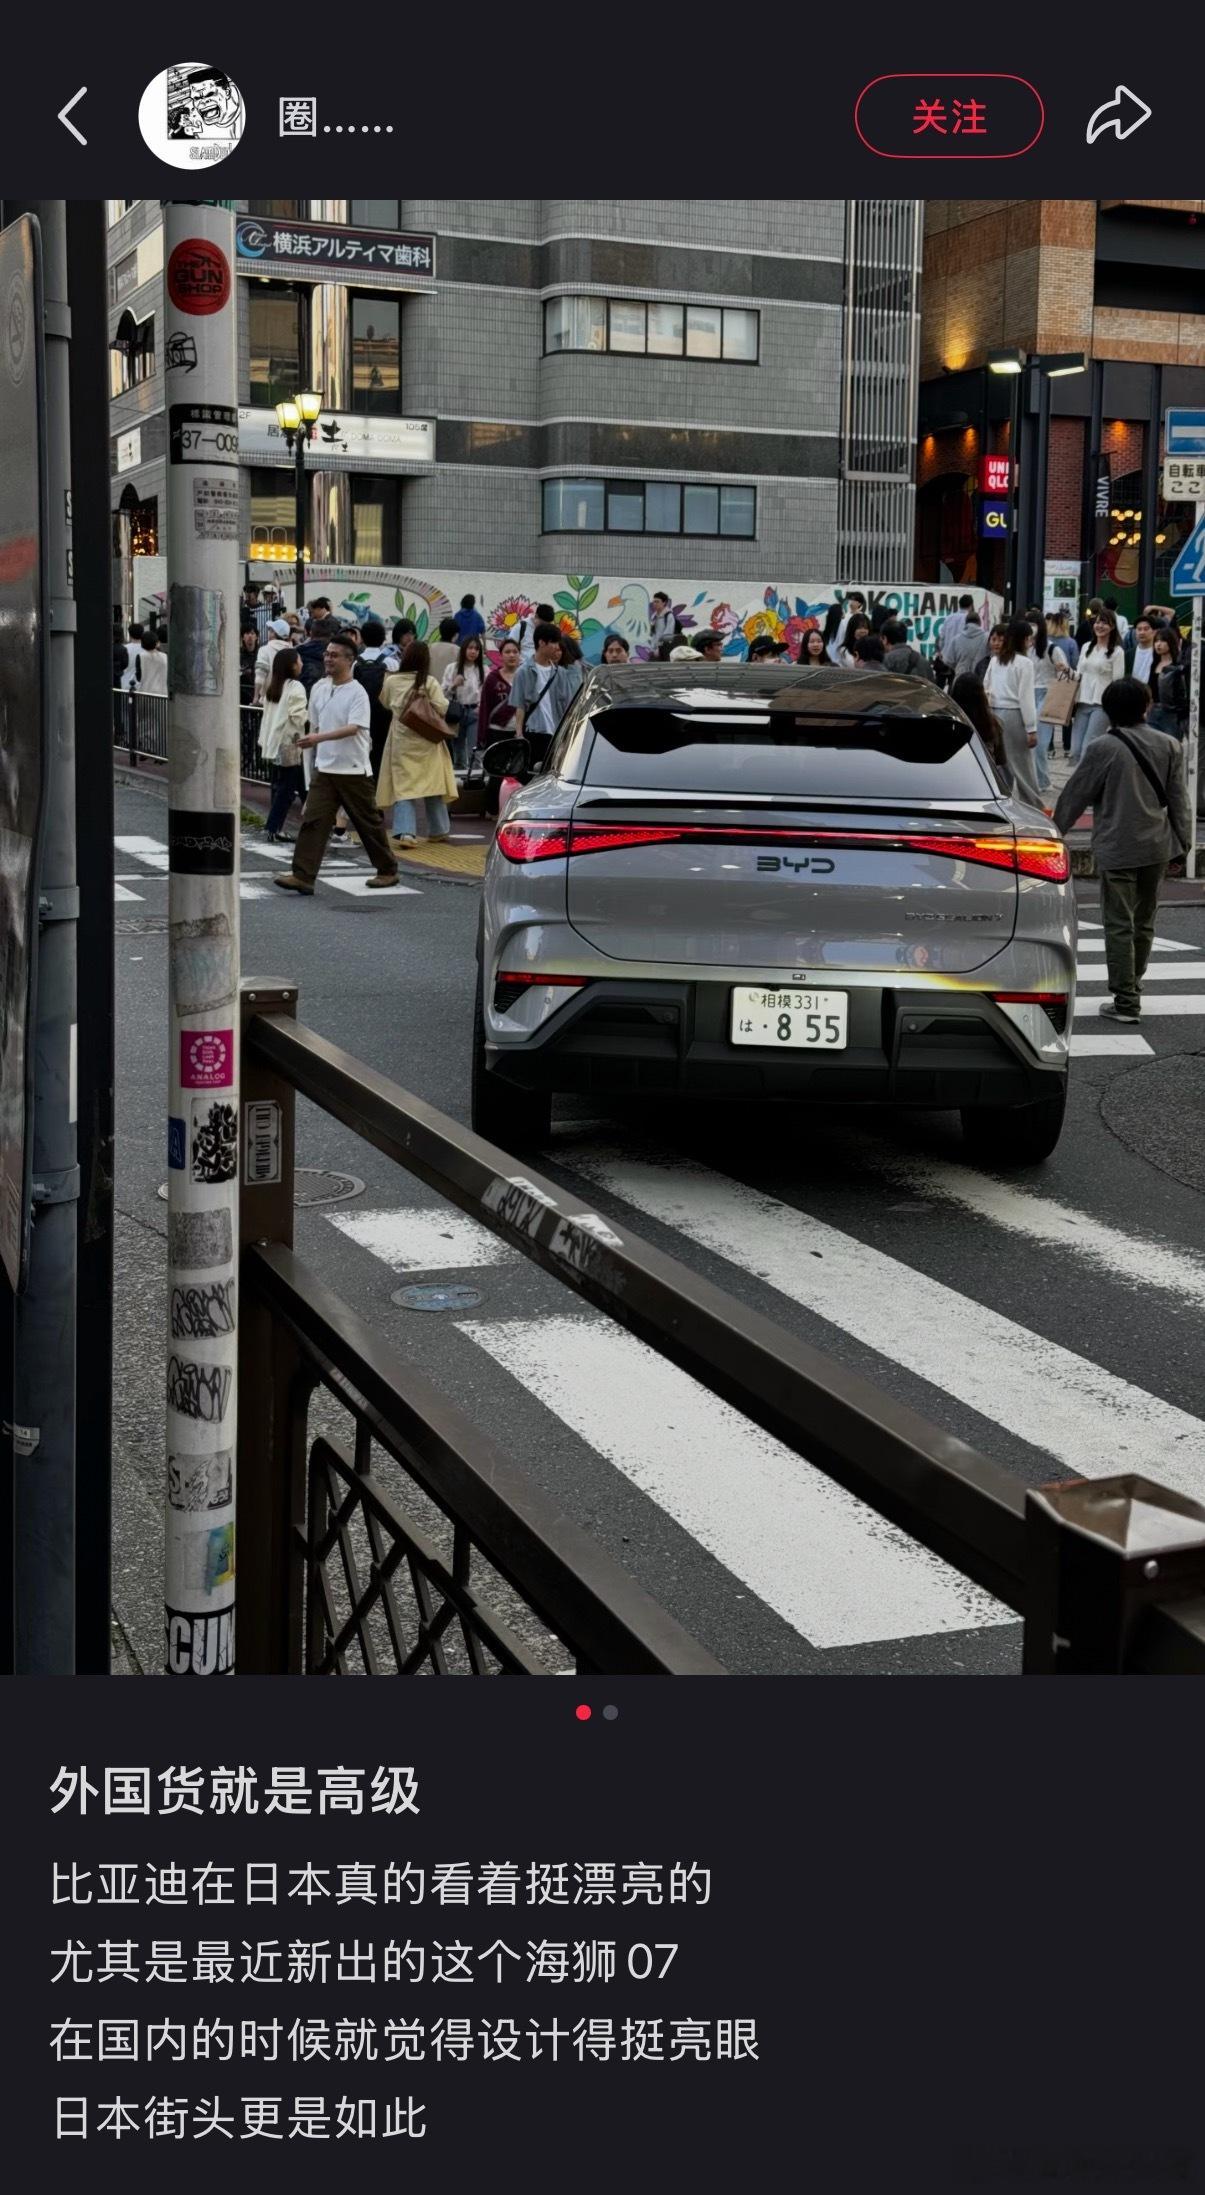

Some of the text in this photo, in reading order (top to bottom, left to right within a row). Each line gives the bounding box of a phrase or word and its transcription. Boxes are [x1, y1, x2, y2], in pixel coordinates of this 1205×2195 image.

[273, 231, 431, 269] 横浜アルティマ歯科
[1095, 475, 1110, 518] VIVRE
[757, 856, 835, 874] BYD
[761, 993, 819, 1010] 相模331
[190, 1072, 226, 1080] ANALOG
